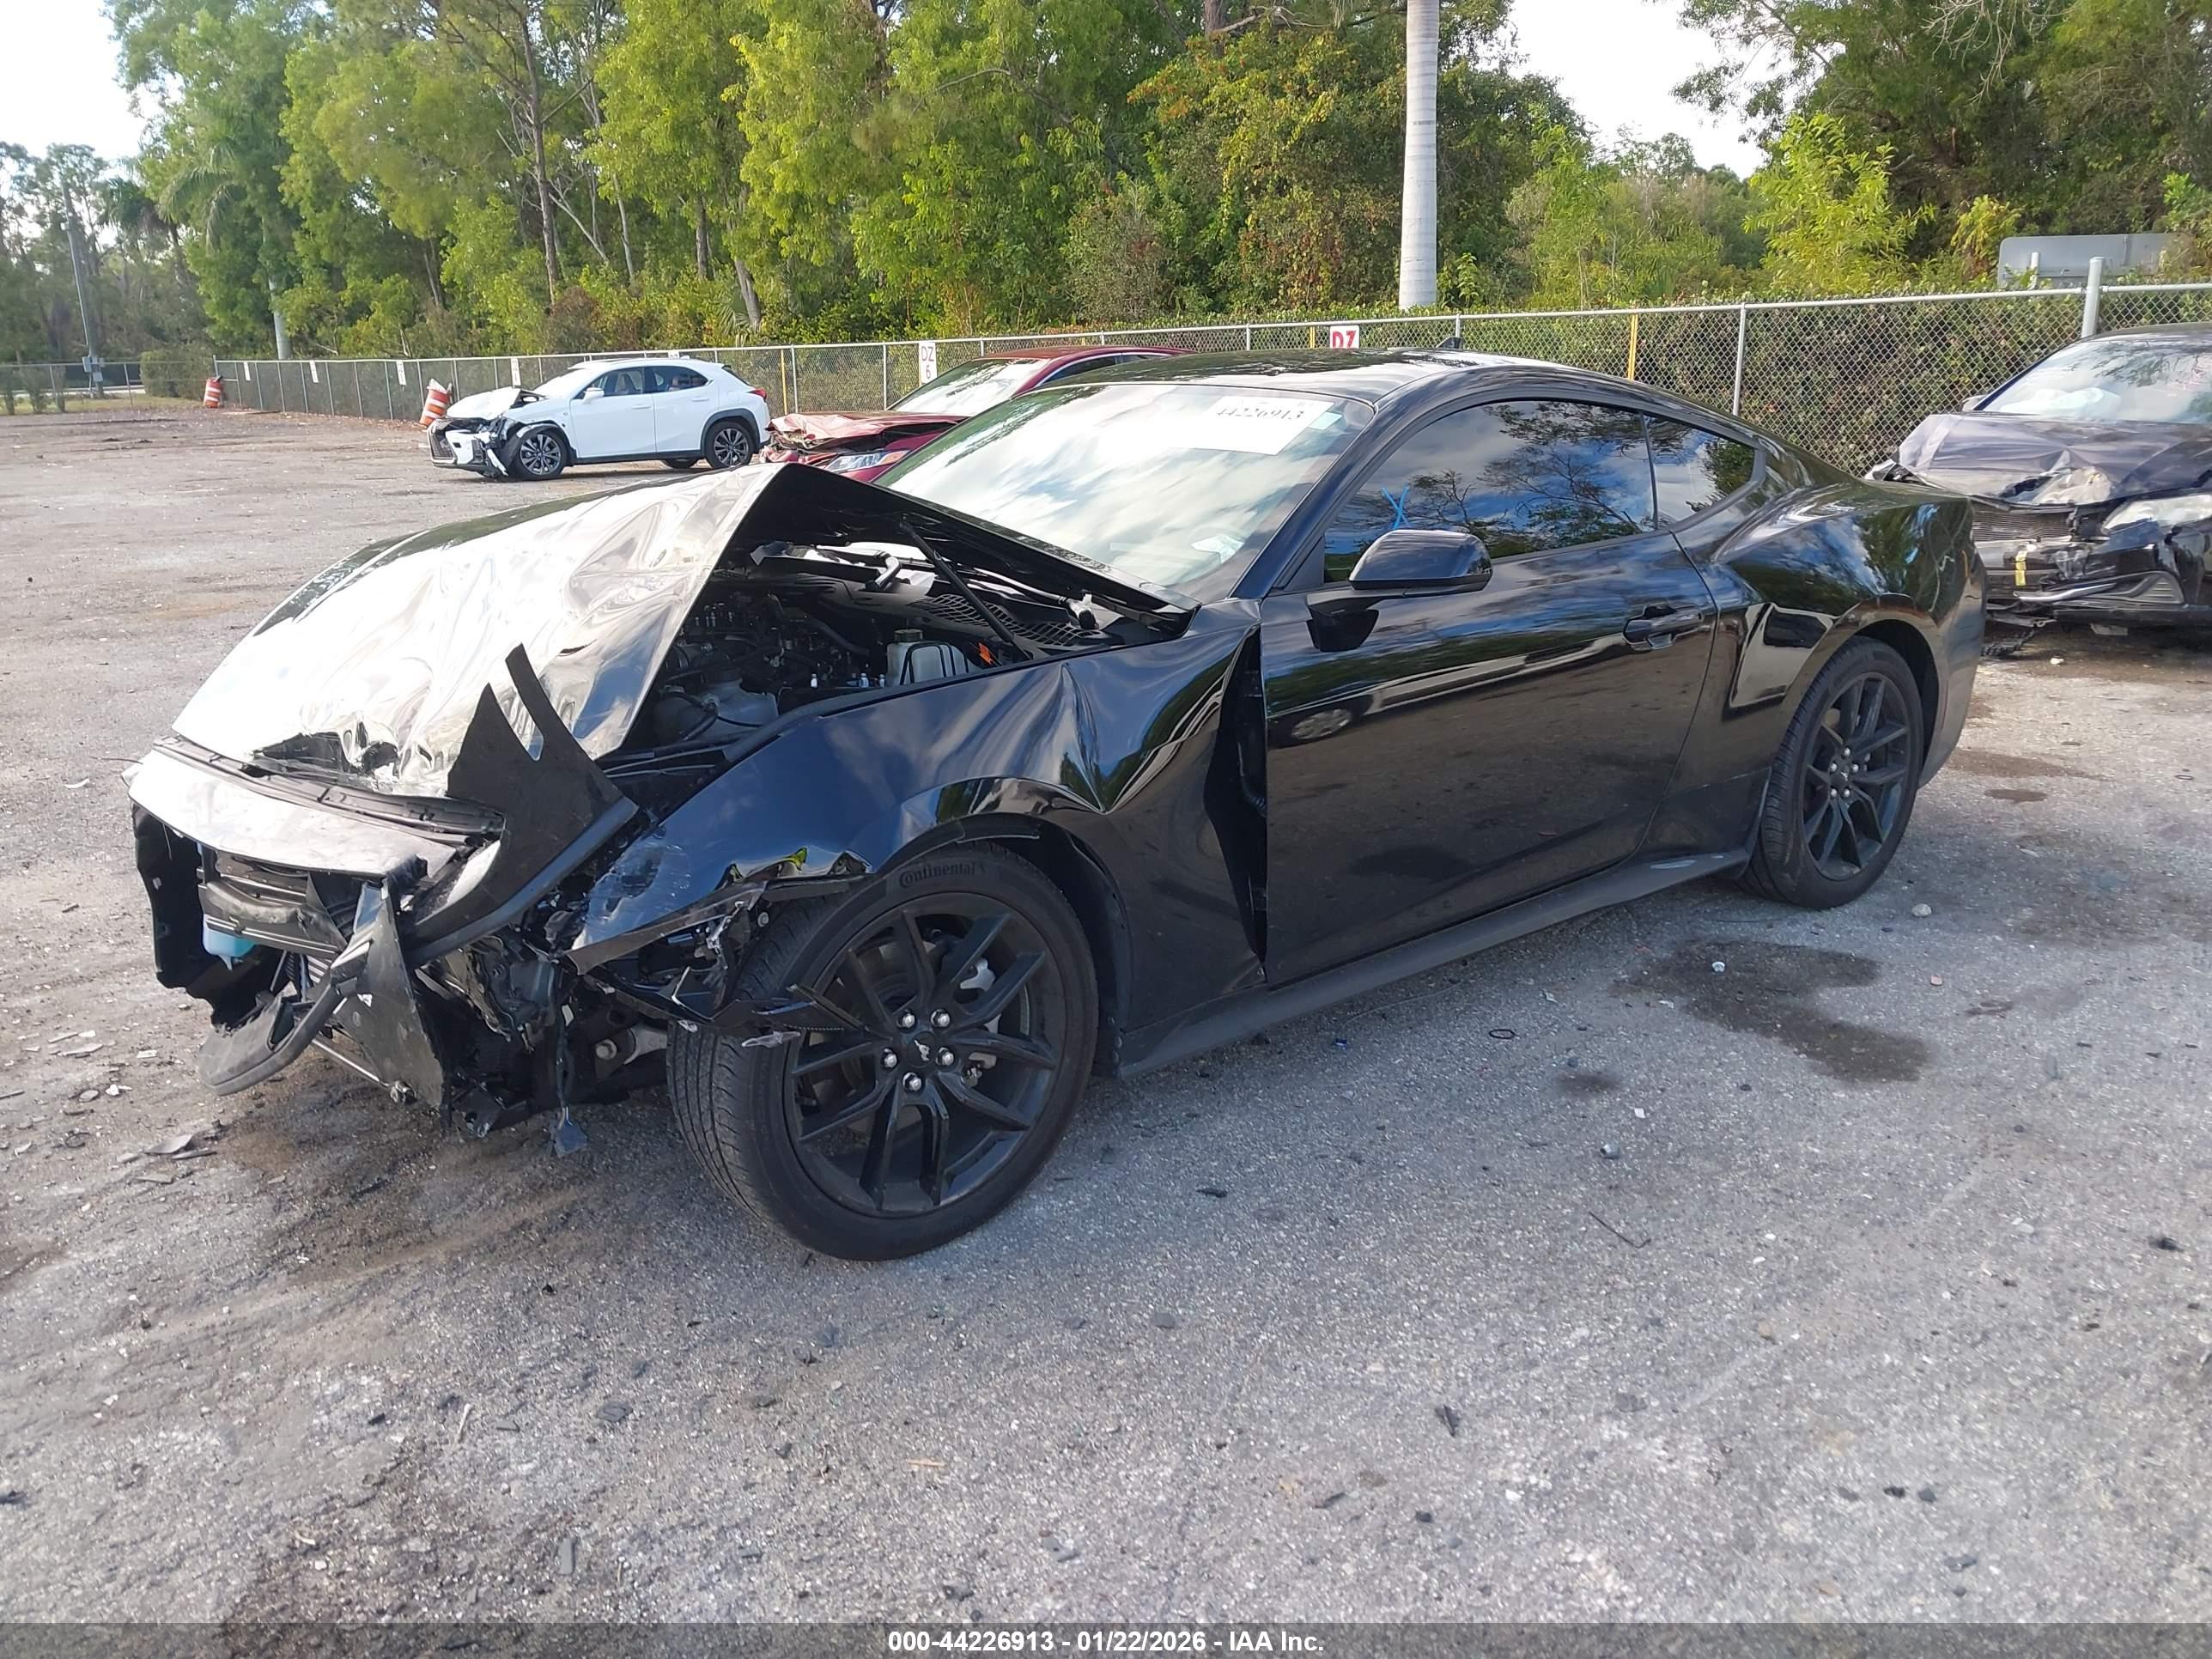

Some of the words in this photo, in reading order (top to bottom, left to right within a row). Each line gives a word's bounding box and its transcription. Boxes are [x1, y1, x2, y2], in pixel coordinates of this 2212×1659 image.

[921, 345, 934, 362] DZ
[926, 364, 932, 380] 6
[898, 861, 976, 889] Continental
